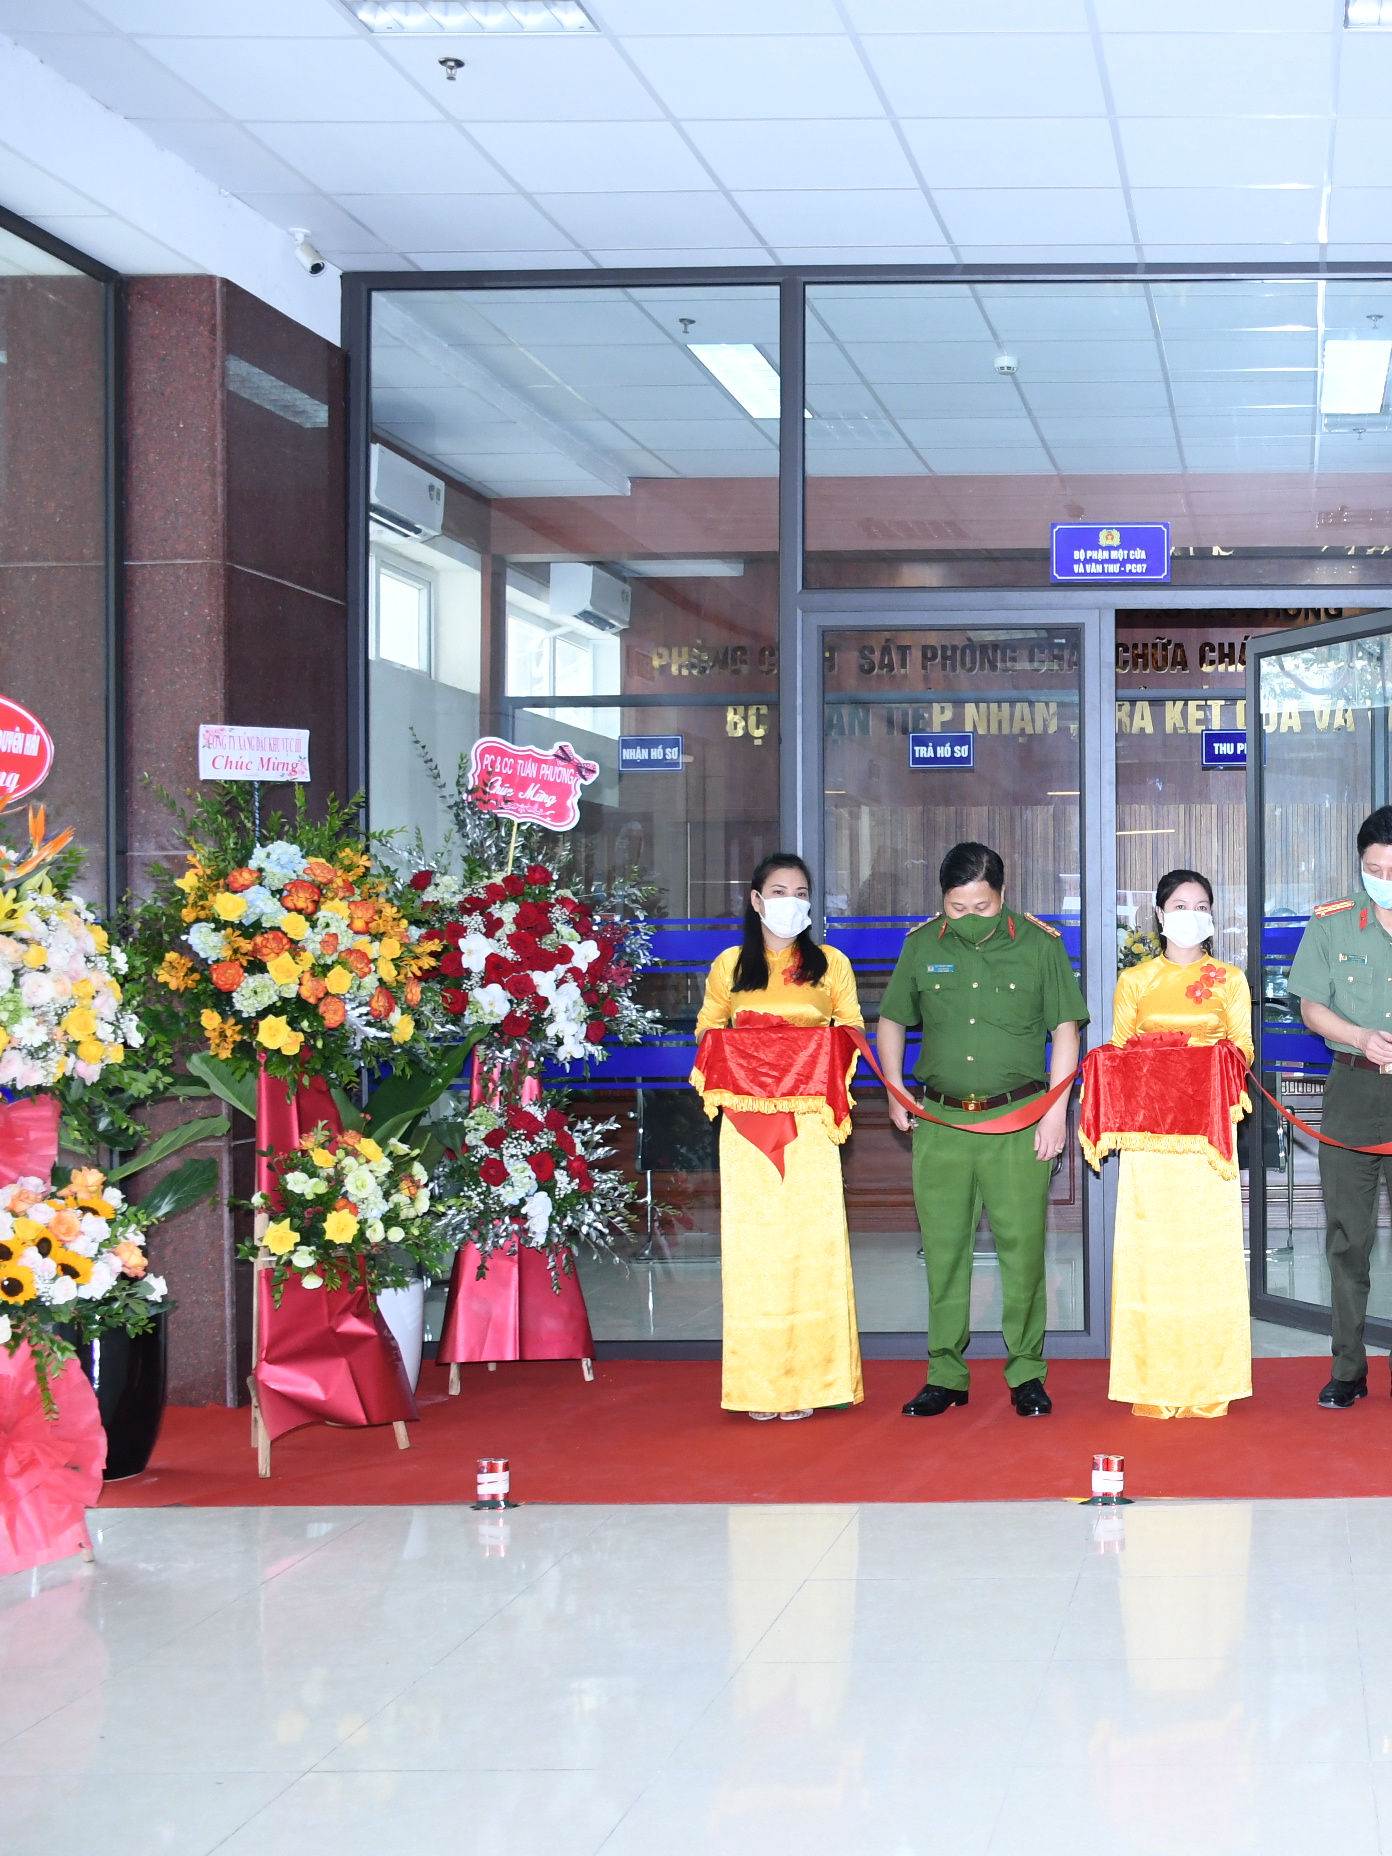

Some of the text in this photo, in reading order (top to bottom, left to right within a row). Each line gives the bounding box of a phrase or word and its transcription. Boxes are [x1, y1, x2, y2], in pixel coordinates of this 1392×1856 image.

[1073, 547, 1146, 561] BỘ PHẬN MỘT CỬA
[1073, 562, 1085, 573] VÀ
[1085, 562, 1103, 573] VĂN
[1103, 563, 1120, 573] THƯ
[1125, 564, 1147, 573] PC07
[652, 639, 748, 676] PHÒNG
[858, 639, 911, 676] SÁT
[921, 637, 1017, 676] PHÒNG
[1116, 635, 1189, 674] CHỮA
[622, 746, 649, 763] NHẬN
[665, 747, 679, 760] SƠ
[914, 742, 935, 758] TRẢ
[953, 745, 969, 758] SƠ
[1213, 742, 1234, 755] THU
[211, 754, 300, 777] Chúc Mừng
[482, 754, 495, 772] PC
[502, 757, 514, 774] CC
[486, 776, 557, 807] Chúc Mừng
